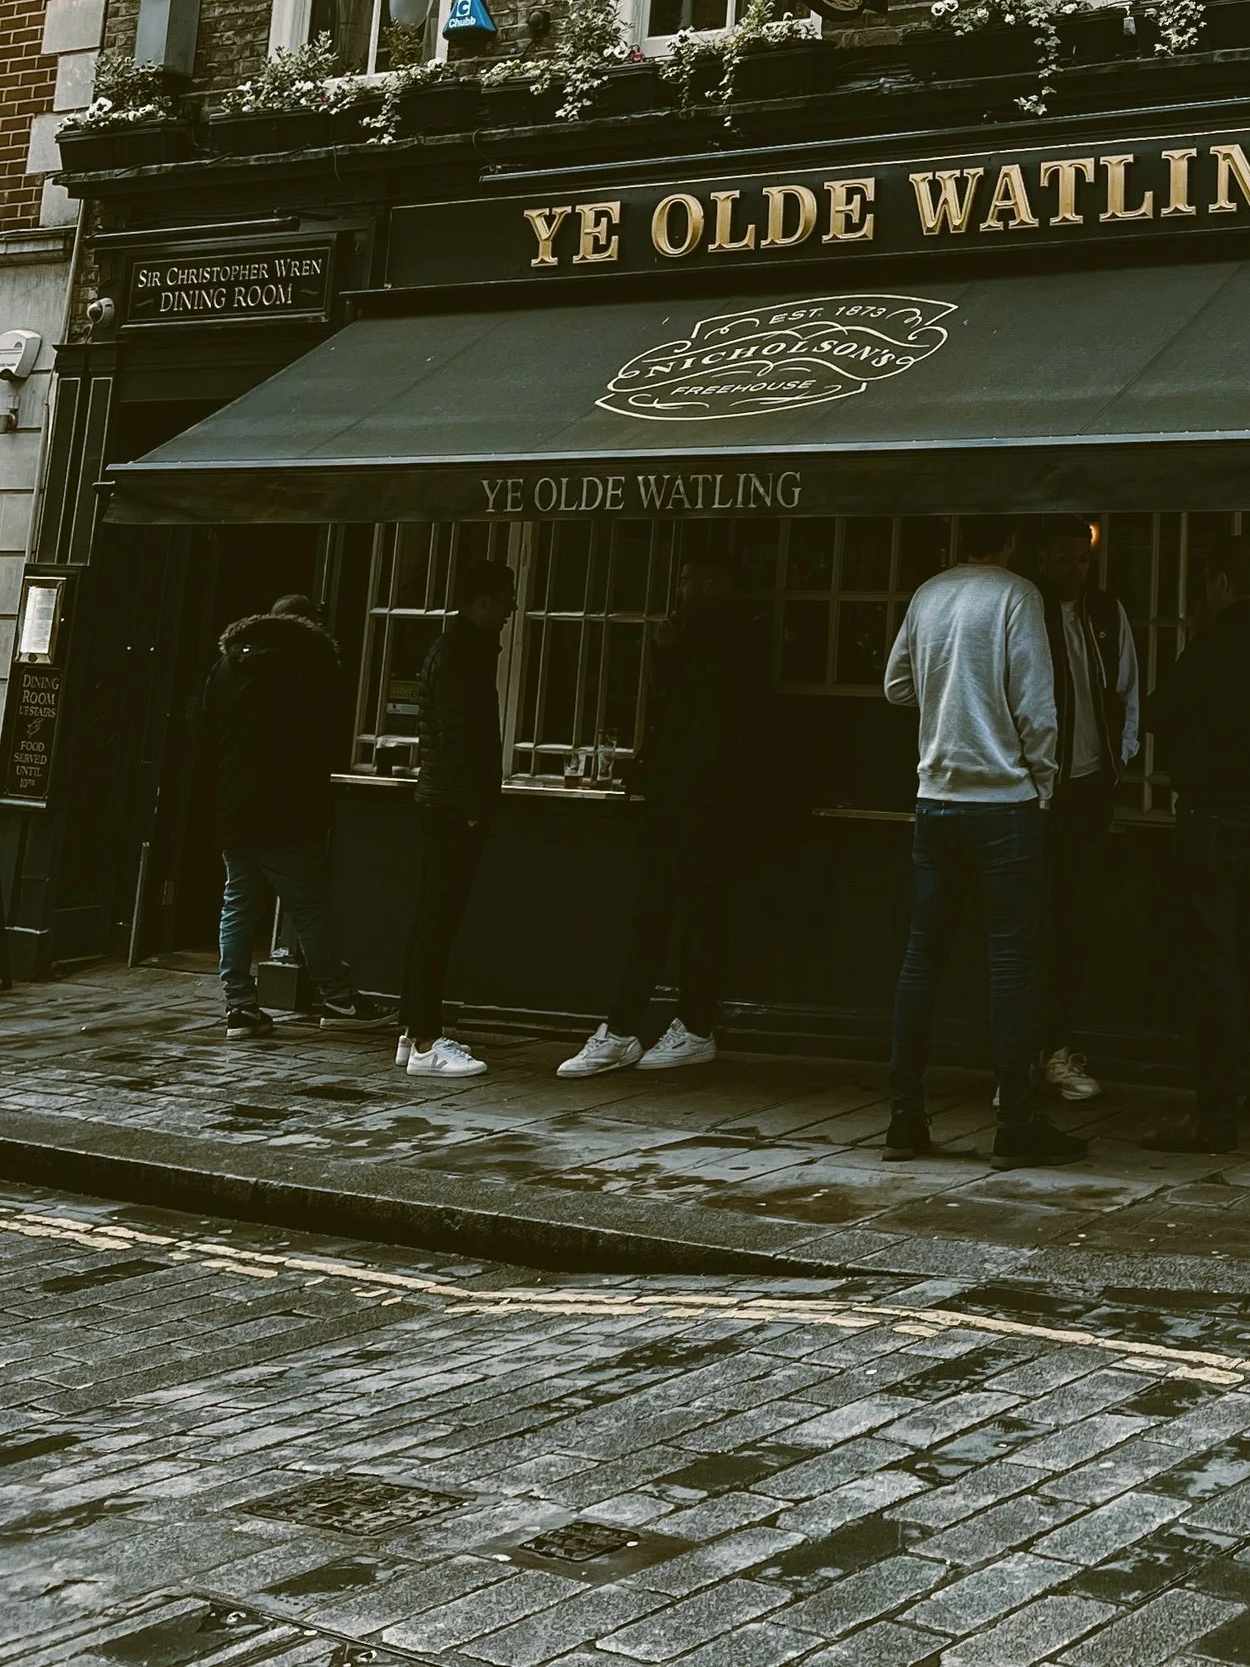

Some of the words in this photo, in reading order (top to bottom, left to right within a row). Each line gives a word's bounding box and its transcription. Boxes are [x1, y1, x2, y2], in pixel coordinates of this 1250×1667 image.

[448, 16, 477, 29] Chubb
[523, 200, 621, 267] YE
[651, 176, 875, 258] OLDE
[166, 263, 269, 286] CHRISTOPHER
[274, 258, 322, 278] WREN
[159, 288, 227, 312] DINING
[233, 283, 293, 308] ROOM
[769, 307, 823, 325] EST.
[834, 305, 887, 318] 1873
[644, 339, 895, 379] NICHOLSON'S
[670, 379, 817, 396] FREEHOUSE
[481, 478, 524, 512] YE
[533, 476, 626, 512] OLDE
[637, 471, 802, 510] WATLING
[22, 674, 60, 690] DINING
[22, 689, 55, 705] ROOM
[18, 705, 56, 718] UPSTAIRS
[20, 740, 45, 752] FOOD
[14, 752, 48, 765] SERVED
[16, 765, 42, 777] UNTIL
